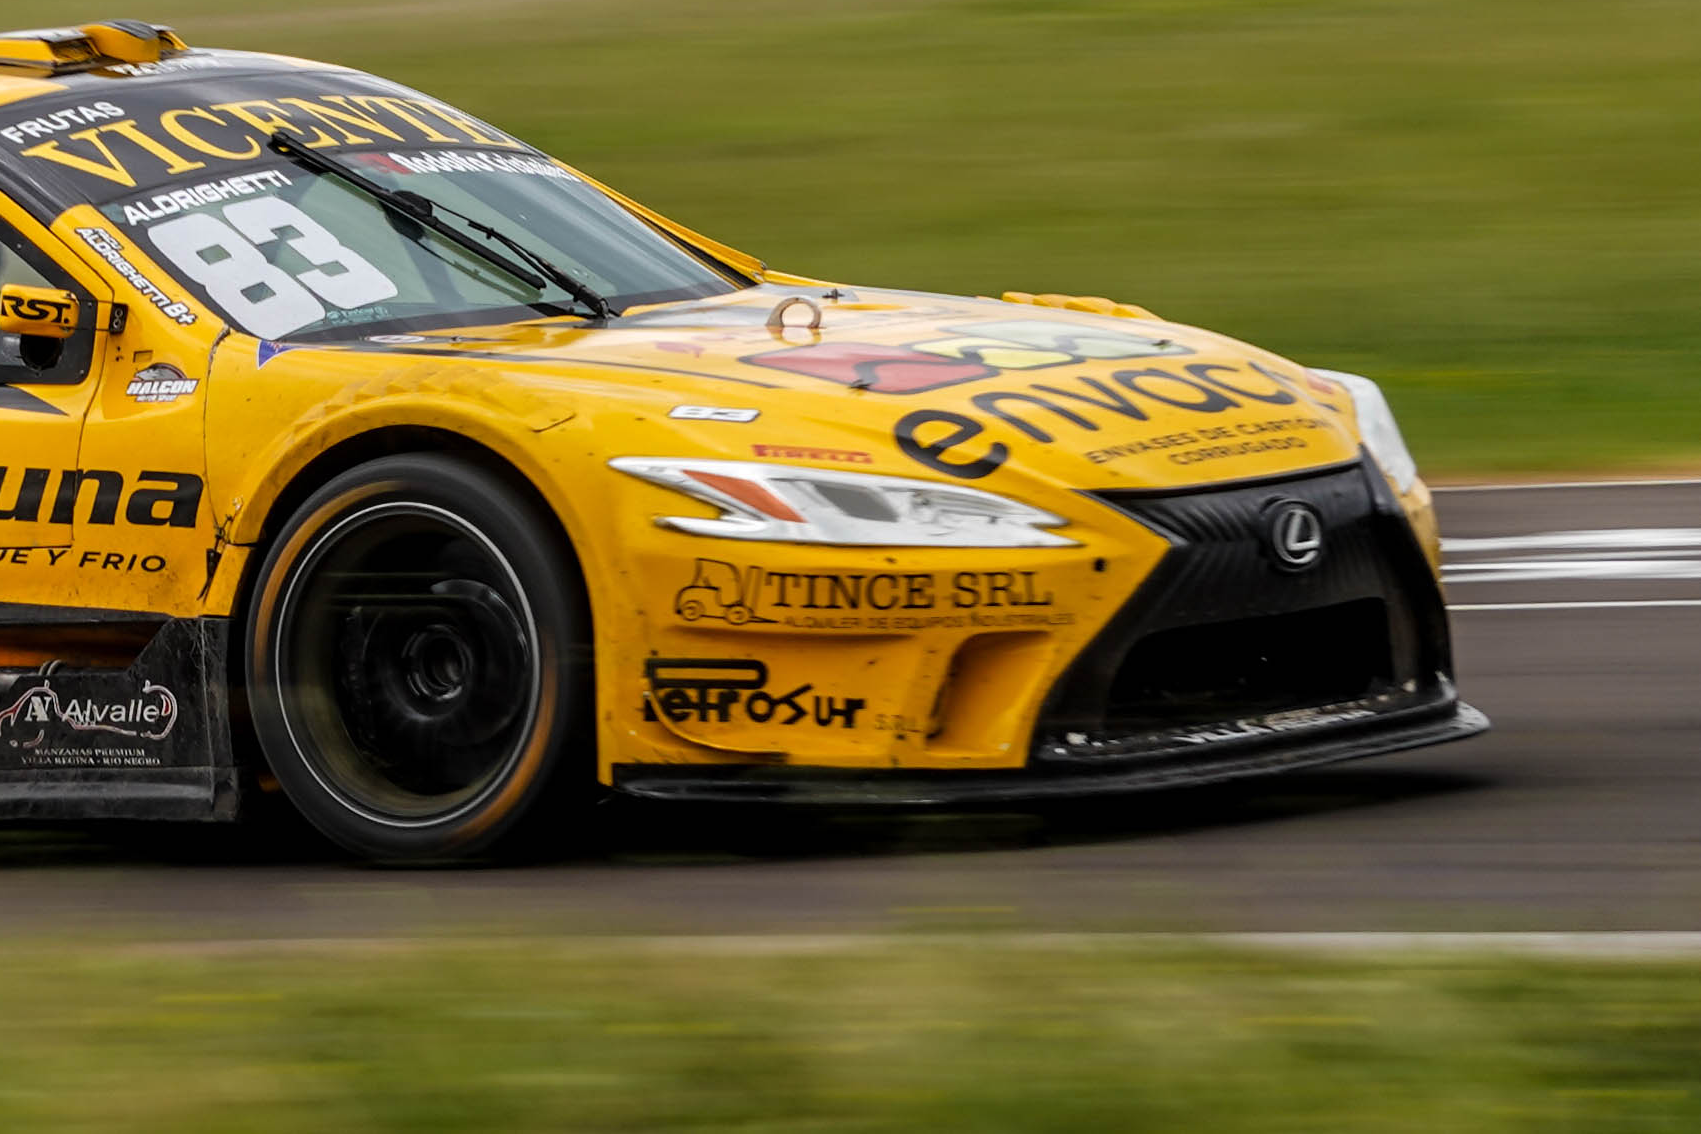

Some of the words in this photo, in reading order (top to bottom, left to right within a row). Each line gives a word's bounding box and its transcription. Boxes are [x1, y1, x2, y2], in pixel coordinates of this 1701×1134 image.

[0, 101, 125, 144] FRUTAS
[20, 95, 524, 188] VICENTE
[123, 169, 294, 226] ALDRIGHETTI
[74, 226, 172, 307] ALDRIGHETTI
[147, 195, 398, 342] 83
[126, 379, 198, 395] HALCON
[668, 404, 760, 423] 83
[1085, 431, 1198, 465] ENVASES
[1198, 426, 1236, 441] DE
[1168, 436, 1308, 466] CORRUGADO
[47, 548, 67, 567] Y
[78, 551, 167, 574] FRIO
[765, 570, 935, 611] TINCE
[952, 570, 1054, 608] SRL
[60, 698, 160, 723] Alvalle
[34, 748, 92, 757] MANZANAS
[94, 748, 146, 757] PREMIUM
[123, 755, 162, 766] NEGRO
